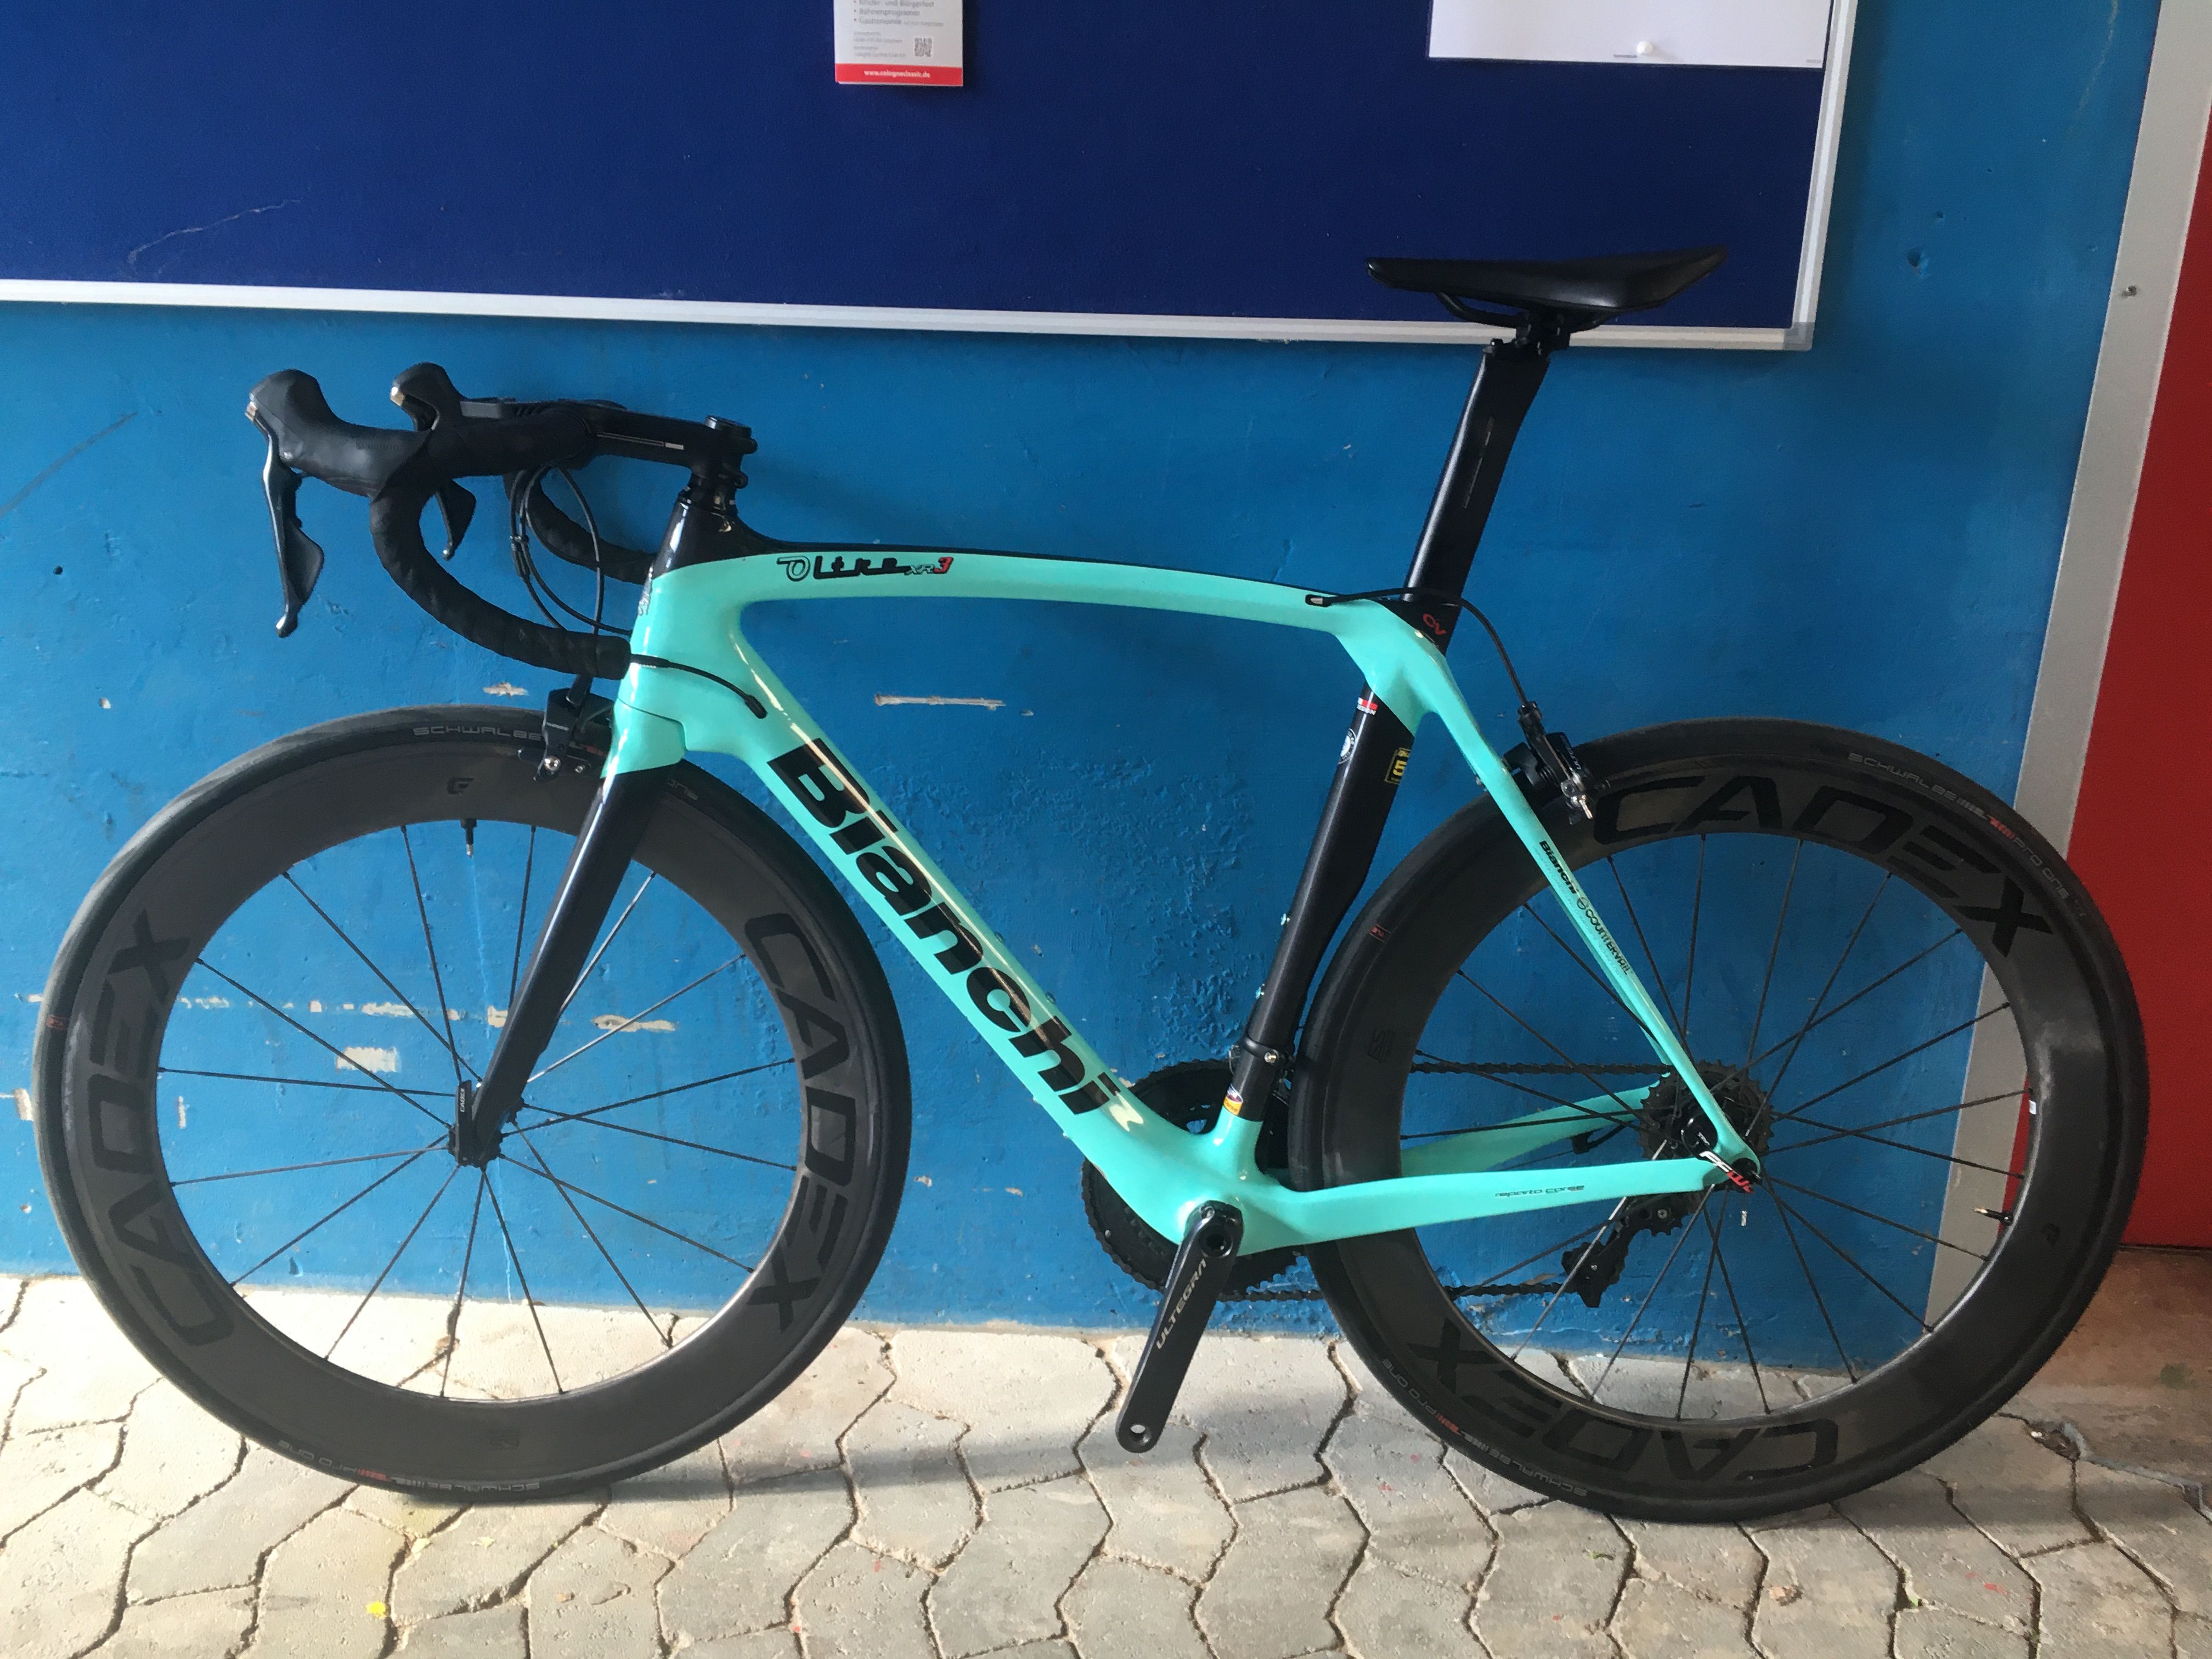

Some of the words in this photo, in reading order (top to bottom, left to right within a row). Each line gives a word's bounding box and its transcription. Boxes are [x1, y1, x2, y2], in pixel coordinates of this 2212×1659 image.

[412, 725, 543, 741] SCHWALBE
[1848, 752, 1957, 801] SCHWALBE
[768, 738, 1121, 1115] Bianchi
[1539, 840, 1579, 894] Bianchi
[1594, 775, 2053, 958] CADEX
[89, 909, 234, 1346] CADEX
[744, 913, 857, 1334] CADEX
[1155, 1259, 1207, 1350] ULTEGRA
[1408, 1317, 1839, 1481] CADEX
[1488, 1448, 1588, 1497] SCHWALBE
